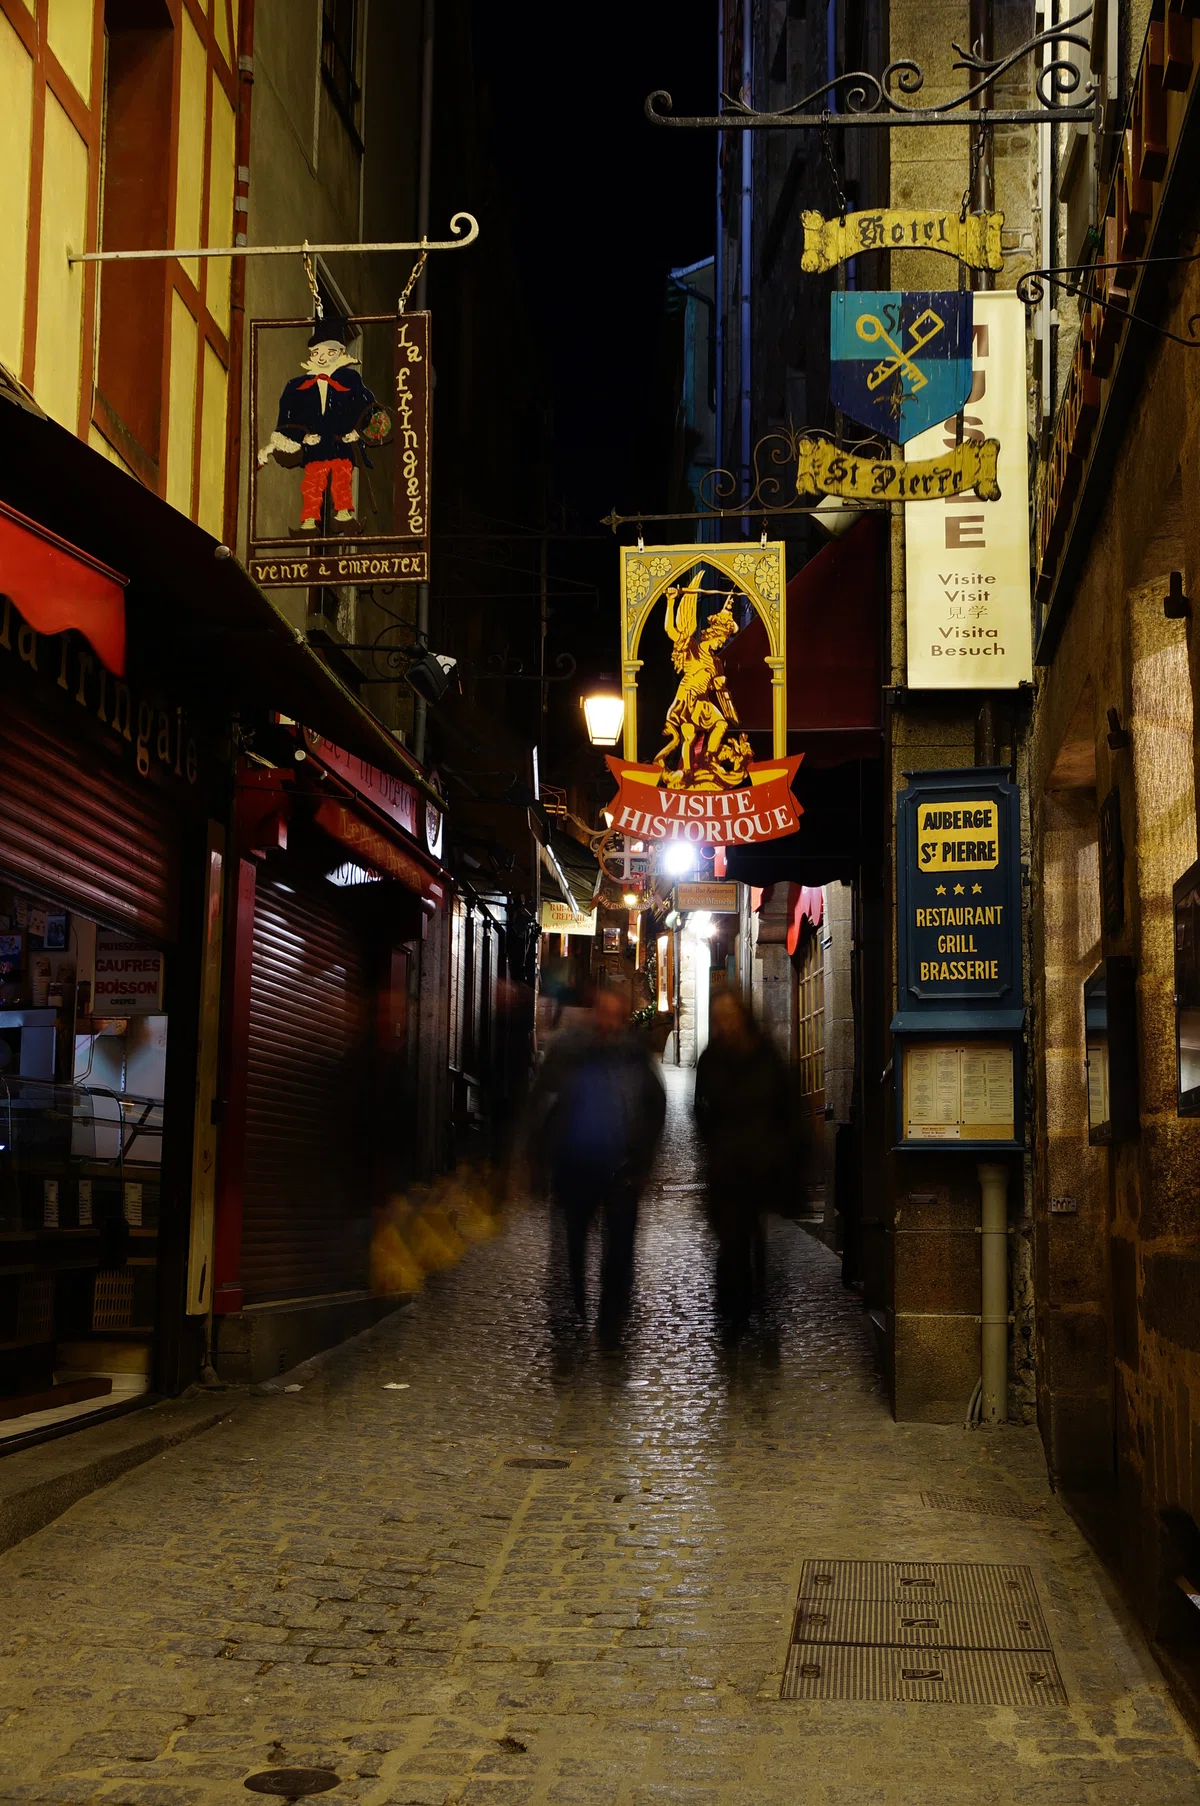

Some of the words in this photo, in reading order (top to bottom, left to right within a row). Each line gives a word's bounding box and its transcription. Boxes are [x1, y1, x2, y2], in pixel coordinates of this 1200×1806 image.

[858, 215, 949, 247] Hotel
[397, 323, 423, 363] La
[396, 366, 424, 534] fringale
[824, 456, 859, 486] St
[871, 463, 962, 497] Pierre
[937, 573, 997, 586] Visite
[944, 589, 990, 602] Visit
[947, 605, 988, 620] 見学
[937, 626, 998, 638] Visita
[930, 643, 1005, 656] Besuch
[658, 790, 756, 818] VISITE
[617, 805, 794, 843] HISTORIQUE
[923, 809, 992, 831] AUBERGE
[942, 840, 996, 863] PIERRE
[916, 905, 1003, 928] RESTAURANT
[938, 934, 978, 954] GRILL
[96, 959, 160, 972] GAUFRES
[920, 960, 999, 982] BRASSERIE
